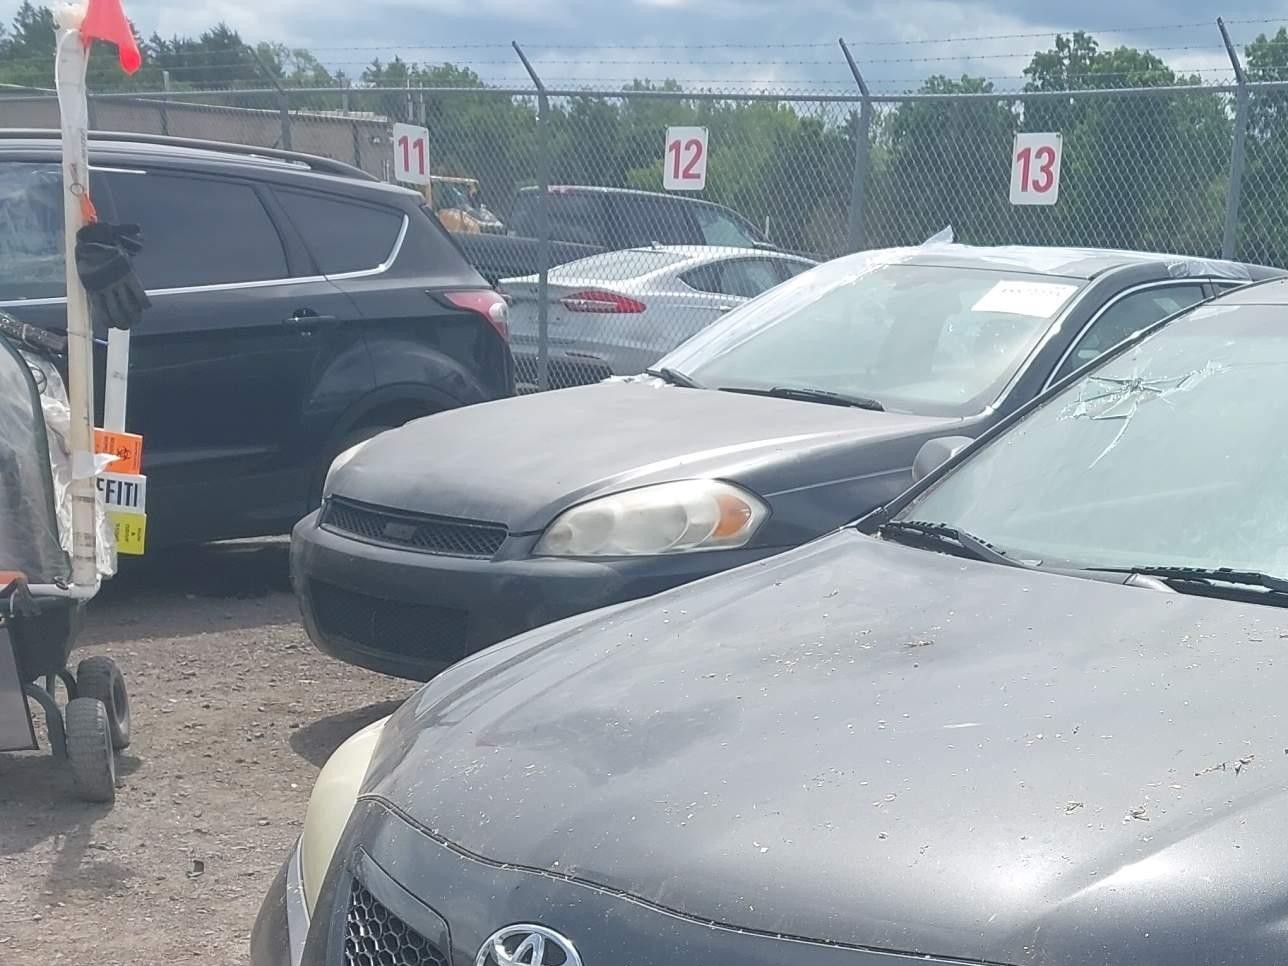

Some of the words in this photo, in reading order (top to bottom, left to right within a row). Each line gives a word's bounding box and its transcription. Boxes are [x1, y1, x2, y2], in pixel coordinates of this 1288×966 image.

[398, 135, 425, 175] 11
[668, 138, 703, 179] 12
[1016, 146, 1056, 193] 13
